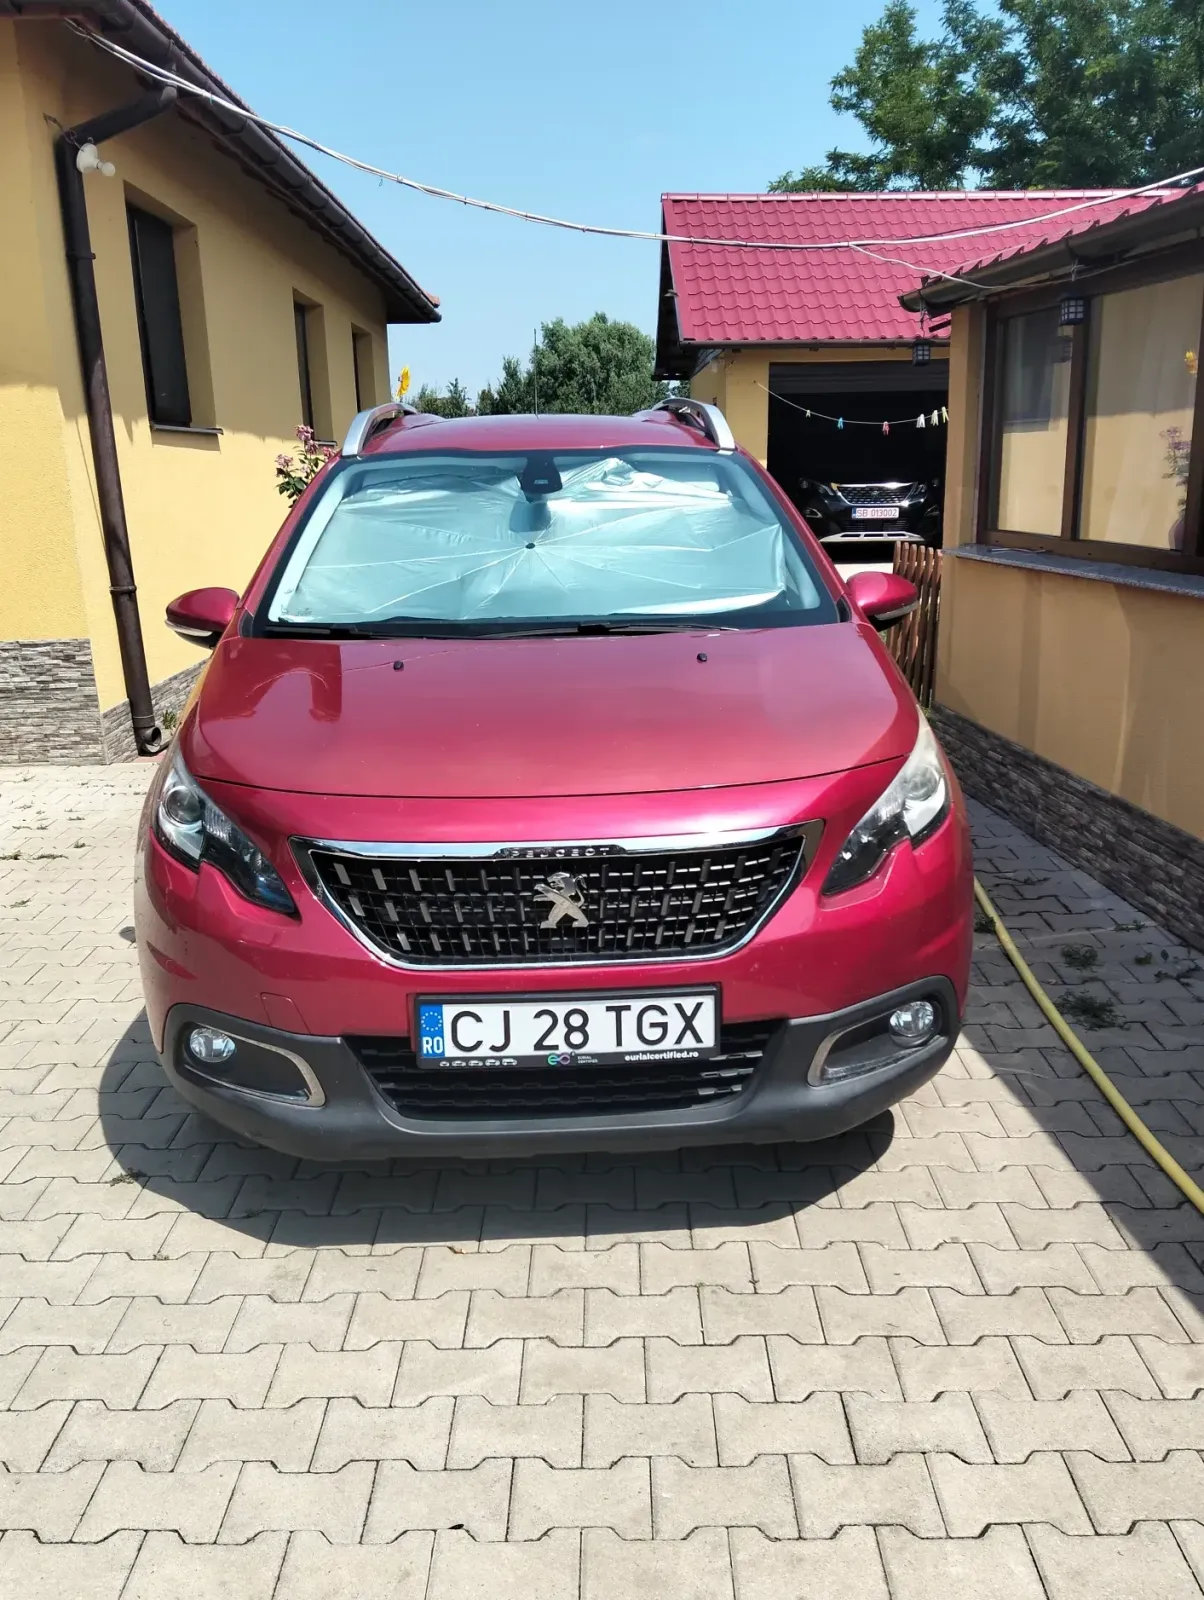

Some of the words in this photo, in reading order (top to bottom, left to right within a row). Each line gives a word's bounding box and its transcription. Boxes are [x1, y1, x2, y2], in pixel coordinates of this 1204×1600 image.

[856, 509, 868, 518] SB
[451, 1010, 511, 1053] CJ
[533, 1008, 590, 1052] 28
[605, 1001, 704, 1048] TGX
[422, 1036, 444, 1054] RO
[624, 1050, 700, 1062] eurialcertified.ro
